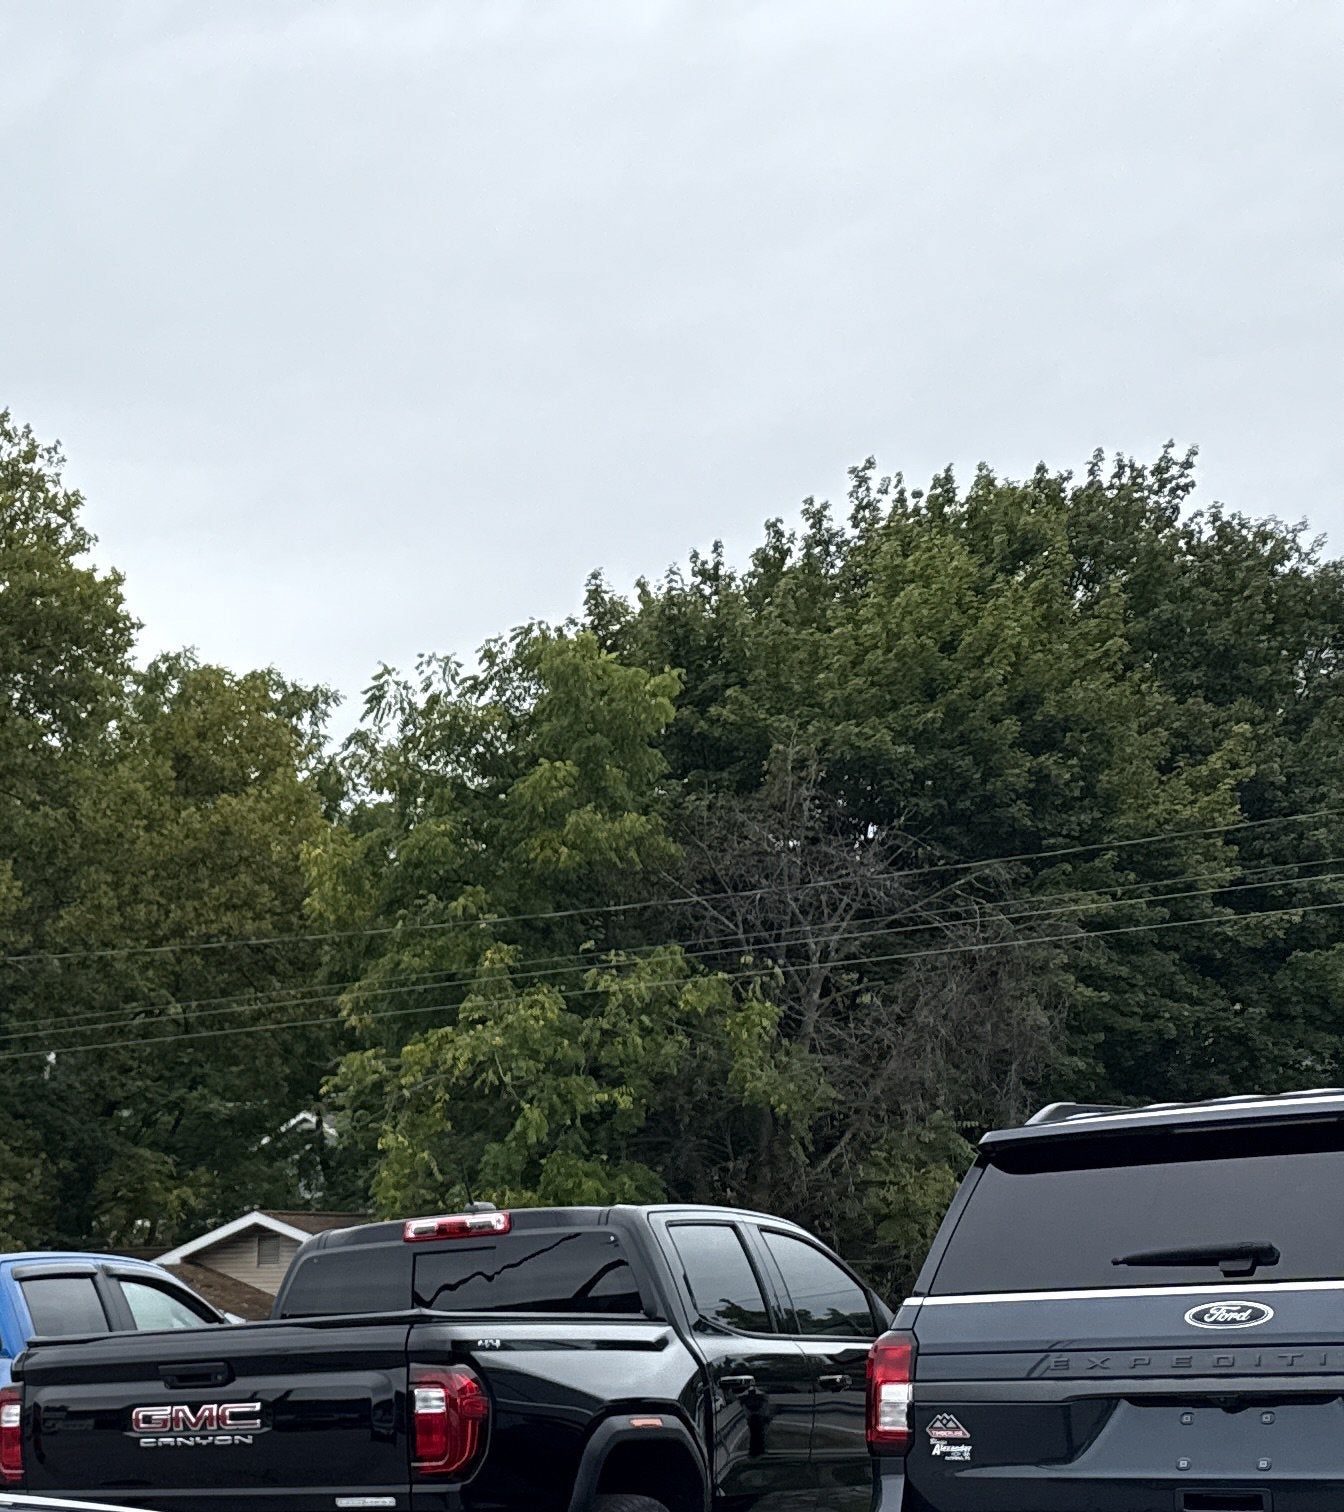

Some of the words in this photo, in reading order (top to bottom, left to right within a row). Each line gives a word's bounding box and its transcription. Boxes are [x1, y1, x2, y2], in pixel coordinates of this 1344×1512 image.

[1203, 1305, 1251, 1323] Ford
[131, 1401, 262, 1433] GMC
[139, 1434, 254, 1448] CANYON
